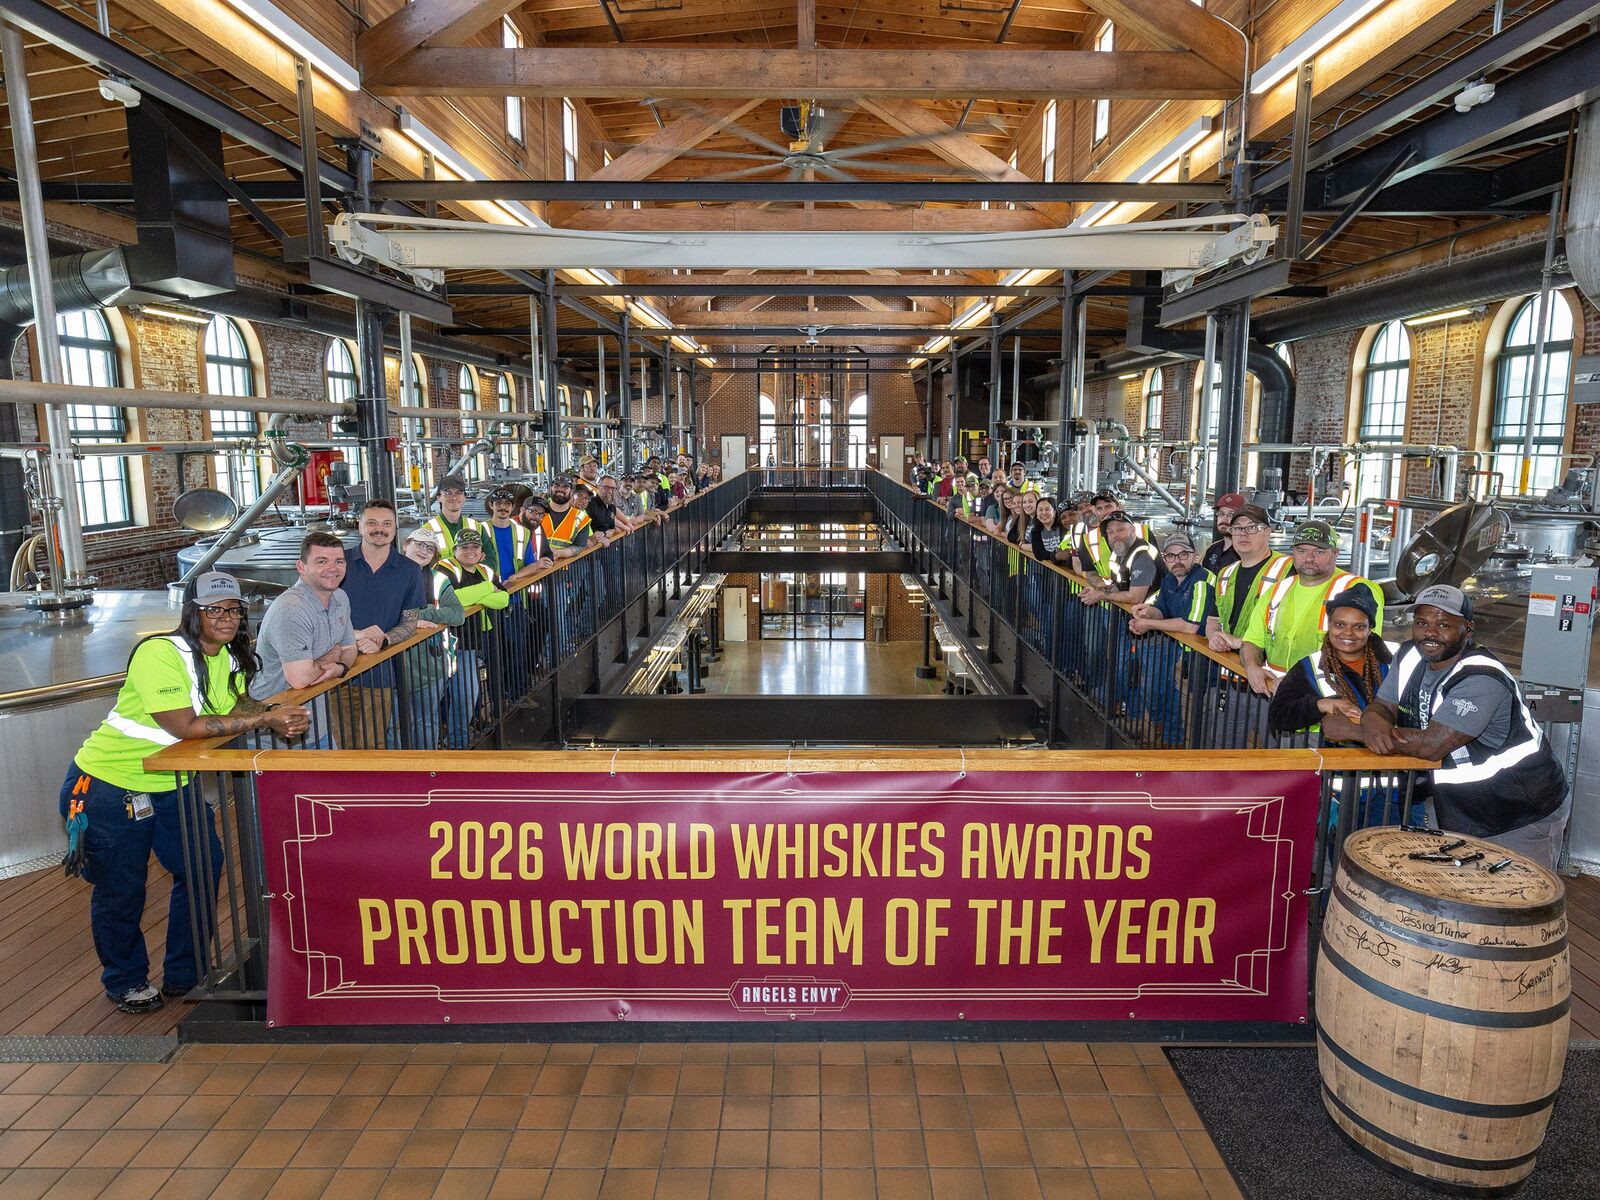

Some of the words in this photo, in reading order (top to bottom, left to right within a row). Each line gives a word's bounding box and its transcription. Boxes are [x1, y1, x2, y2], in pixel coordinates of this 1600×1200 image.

[1529, 700, 1537, 711] A
[429, 820, 544, 881] 2026
[559, 822, 716, 881] WORLD
[730, 821, 945, 880] WHISKIES
[961, 822, 1153, 880] AWARDS
[358, 898, 705, 965] PRODUCTION
[722, 897, 863, 965] TEAM
[885, 898, 951, 966] OF
[968, 899, 1066, 965] THE
[1084, 897, 1216, 964] YEAR
[742, 986, 797, 1003] ANGELS
[801, 986, 839, 1003] ENVY
